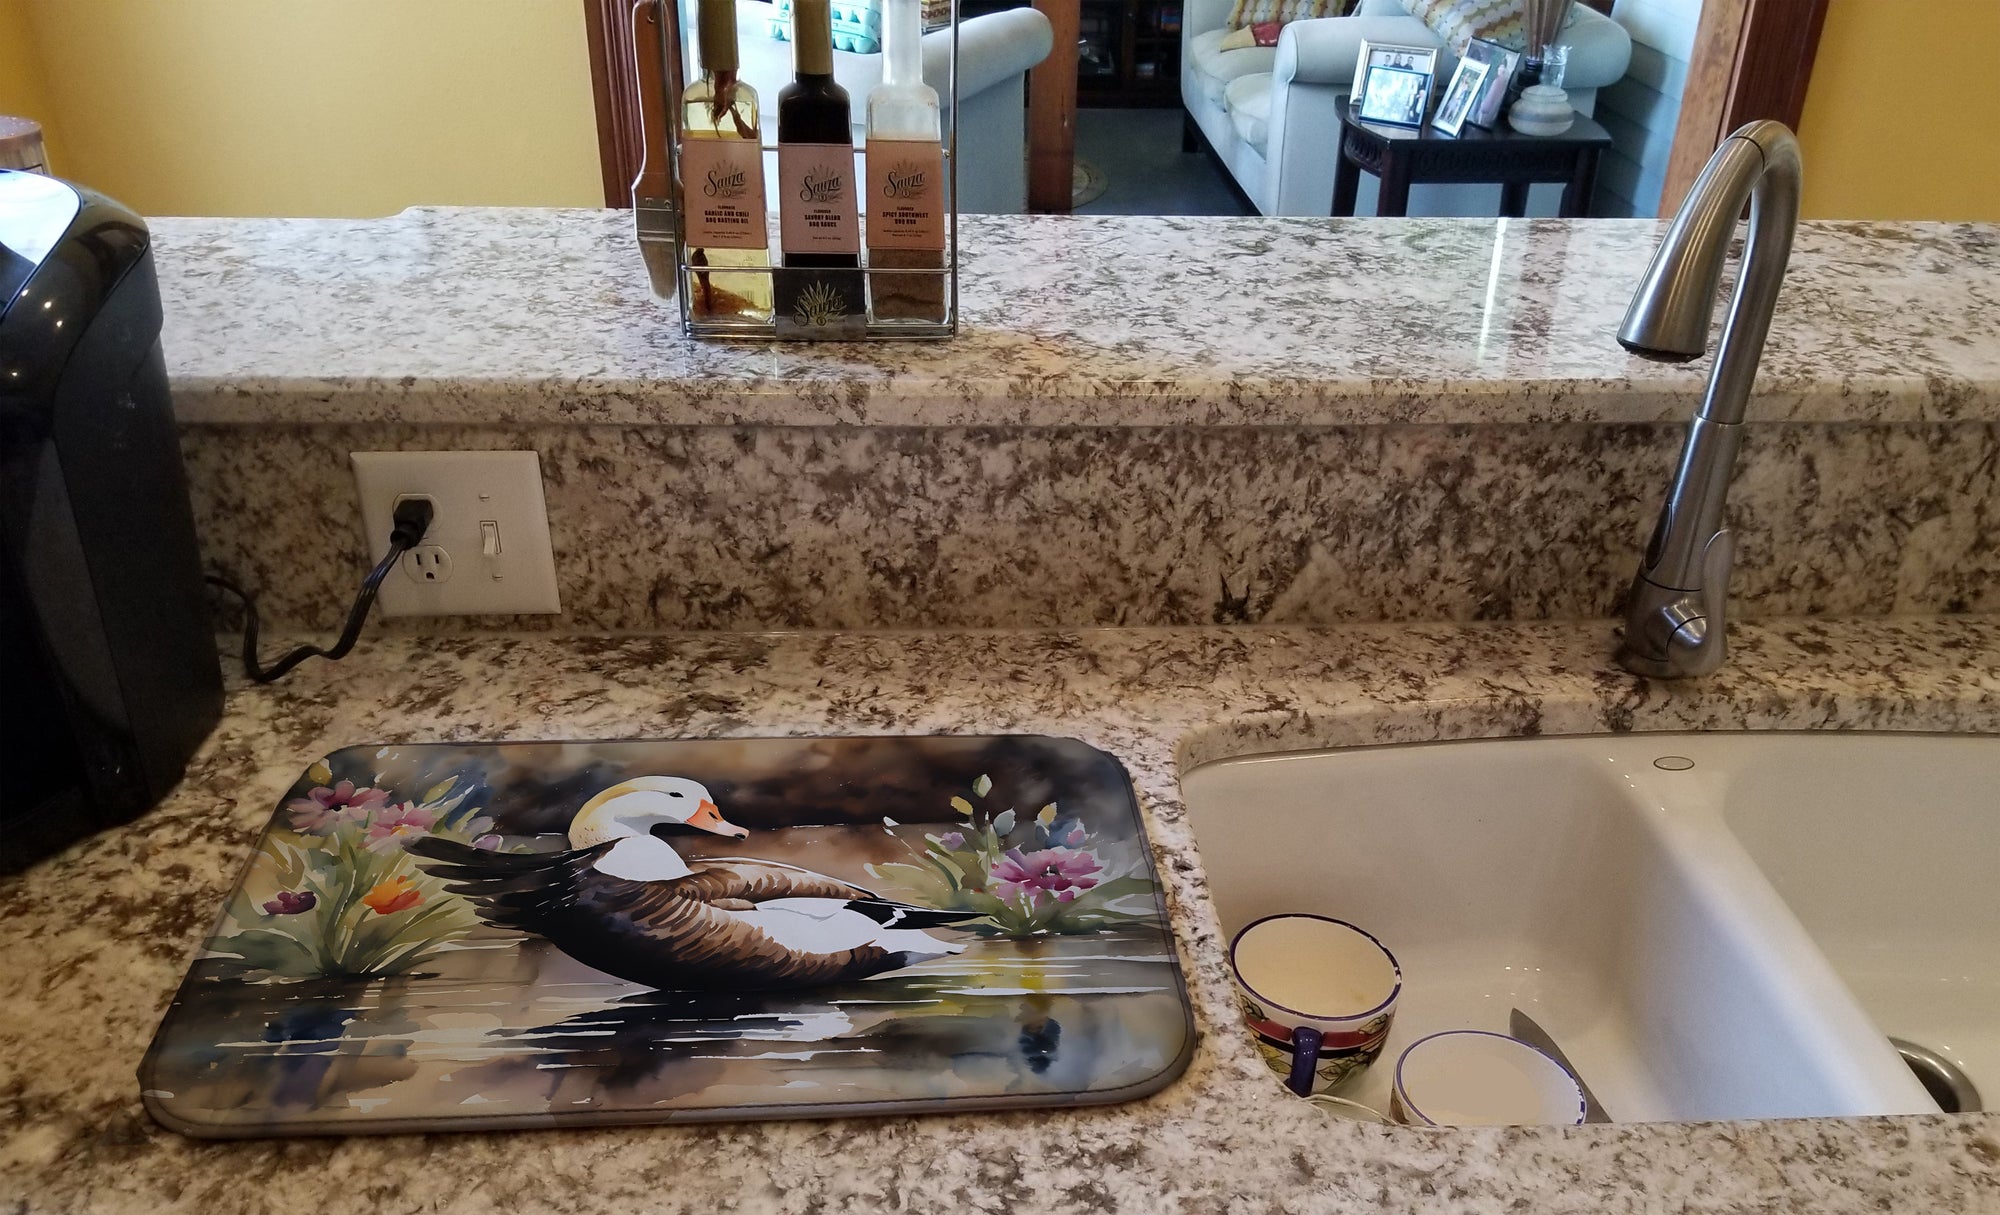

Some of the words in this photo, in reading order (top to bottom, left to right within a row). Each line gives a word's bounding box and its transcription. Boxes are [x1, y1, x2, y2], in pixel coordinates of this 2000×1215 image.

[703, 170, 745, 197] Sauza
[800, 175, 841, 202] Sauza
[883, 171, 925, 198] Sauza
